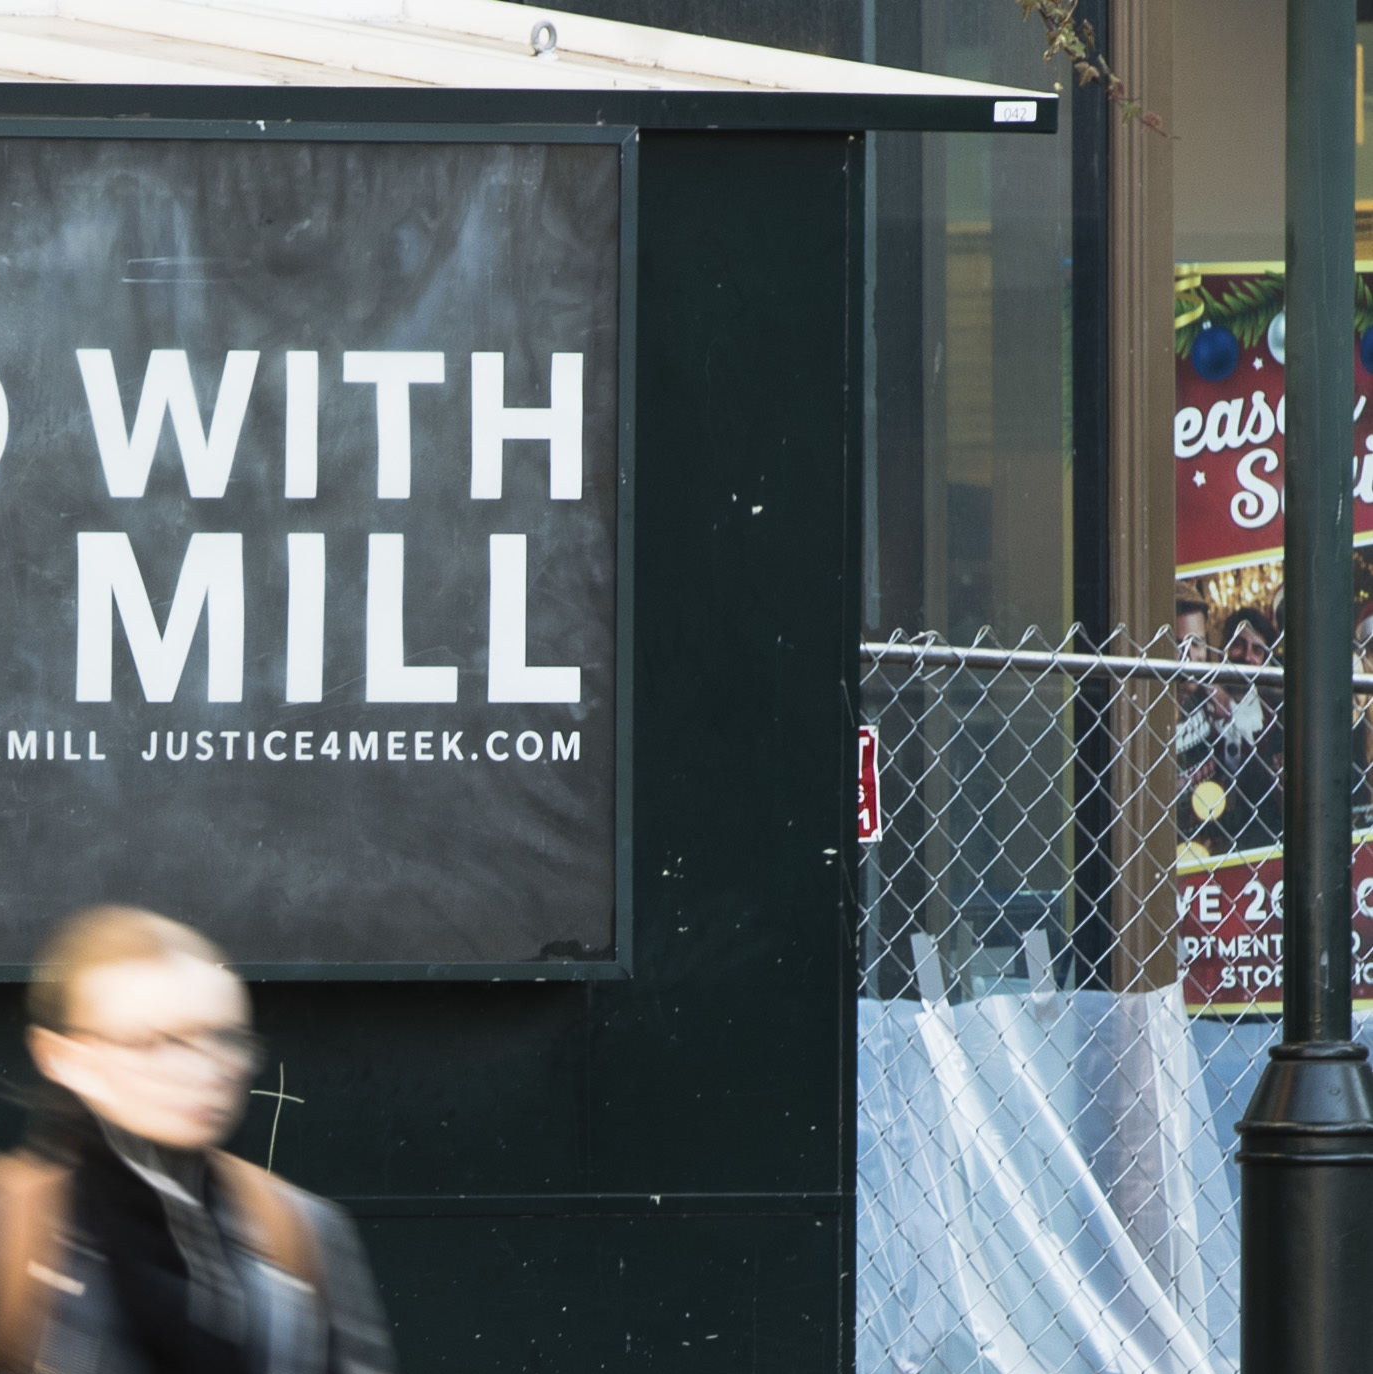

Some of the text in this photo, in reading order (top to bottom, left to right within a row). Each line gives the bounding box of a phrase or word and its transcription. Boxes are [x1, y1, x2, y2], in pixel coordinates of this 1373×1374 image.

[75, 348, 583, 500] WITH
[75, 531, 580, 703] MILL
[141, 730, 581, 762] JUSTICE4MEEK.COM
